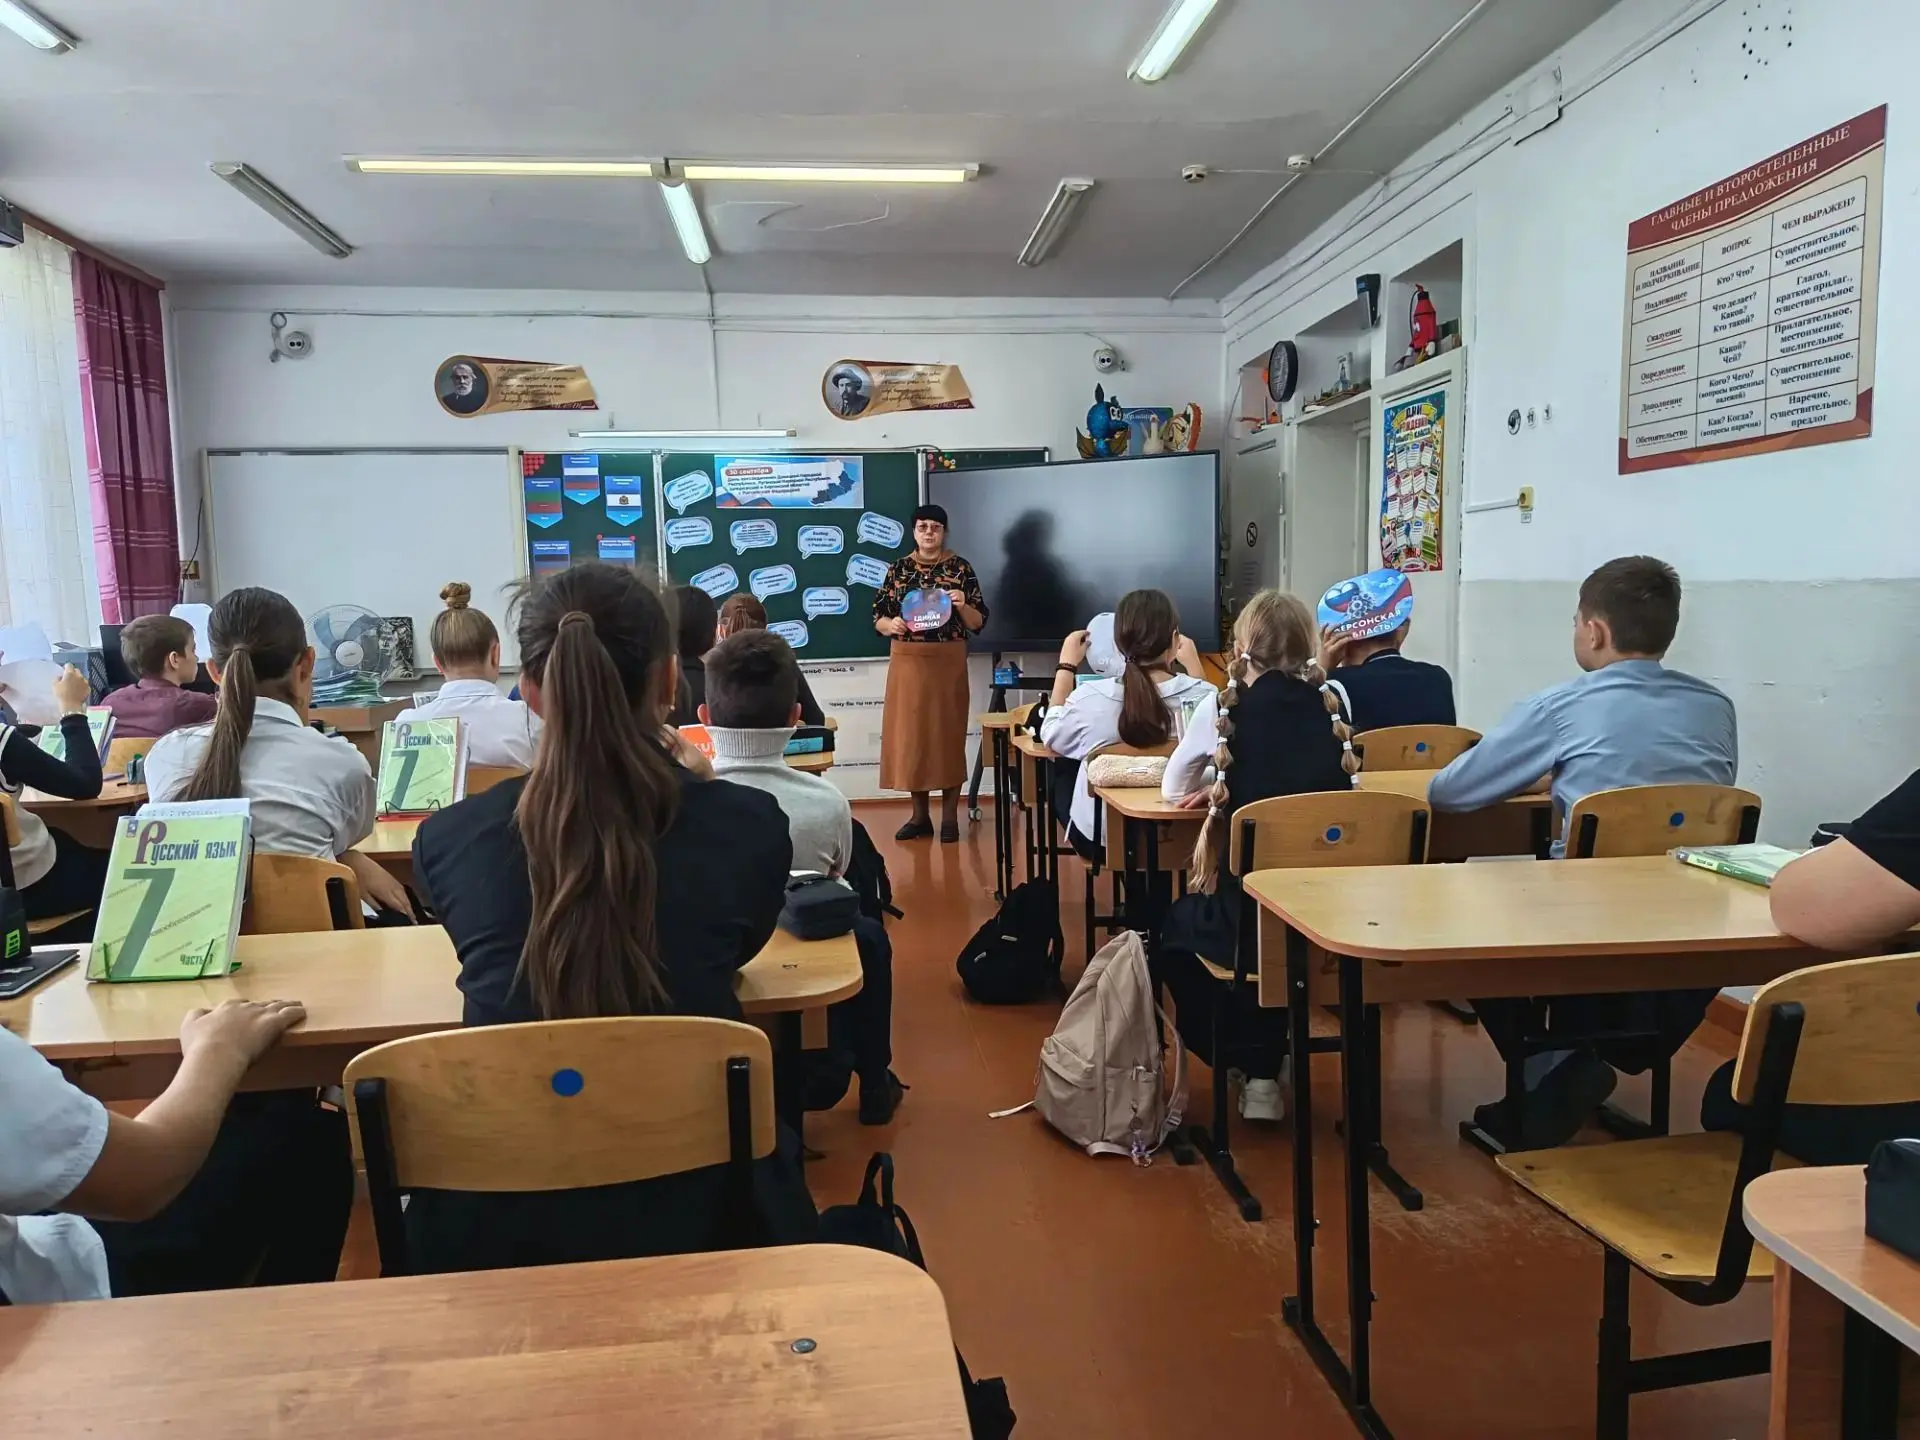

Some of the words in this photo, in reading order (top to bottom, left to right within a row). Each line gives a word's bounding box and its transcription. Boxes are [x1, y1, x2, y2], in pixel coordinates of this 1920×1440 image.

[1651, 193, 1702, 226] ГЛАВНЫЕ
[1705, 189, 1714, 202] И
[1716, 125, 1850, 198] ВТОРОСТЕПЕННЫЕ
[1671, 205, 1712, 231] ЧЛЕНЫ
[1715, 158, 1818, 215] ПРЕДЛОЖЕНИЯ
[1782, 218, 1800, 230] ЧЕМ
[1803, 196, 1856, 223] ВЫРАЖЕН?
[1721, 236, 1752, 255] ВОПРОС
[1775, 224, 1860, 259] Существительное,
[1785, 240, 1847, 266] местоимение
[1716, 273, 1735, 285] Кто?
[1735, 265, 1754, 278] Что?
[1797, 269, 1831, 285] Глагол,
[1644, 291, 1688, 311] Подлежащее
[1712, 302, 1727, 312] Что
[1727, 291, 1757, 309] делает?
[1774, 285, 1854, 315] существительное
[1776, 286, 1812, 304] краткое
[1713, 323, 1727, 333] Кто
[1729, 314, 1755, 329] такой?
[1774, 307, 1853, 334] Прилагательное,
[1646, 327, 1682, 342] Сказуемое
[1781, 321, 1844, 343] местоимение,
[1719, 341, 1747, 355] Какой?
[1780, 332, 1844, 354] числительное
[1723, 353, 1742, 364] Чей?
[1770, 351, 1854, 377] Существительное,
[1640, 364, 1686, 381] Определение
[1709, 375, 1731, 388] Кого?
[1732, 369, 1754, 381] Чего?
[1781, 365, 1842, 385] местоимение
[1789, 390, 1831, 405] Наречие,
[1708, 414, 1726, 426] Как?
[1727, 410, 1754, 422] Когда?
[1770, 398, 1852, 420] существительное,
[1791, 414, 1828, 427] предлог
[1635, 429, 1688, 444] Обстоятельство
[914, 613, 940, 622] ЕДИНАЯ
[914, 621, 940, 629] СТРАНА!
[1352, 622, 1394, 638] БЛАСТЬ!
[391, 750, 419, 810] 7
[131, 820, 200, 866] Русский
[205, 841, 237, 859] язык
[109, 868, 176, 978] 7
